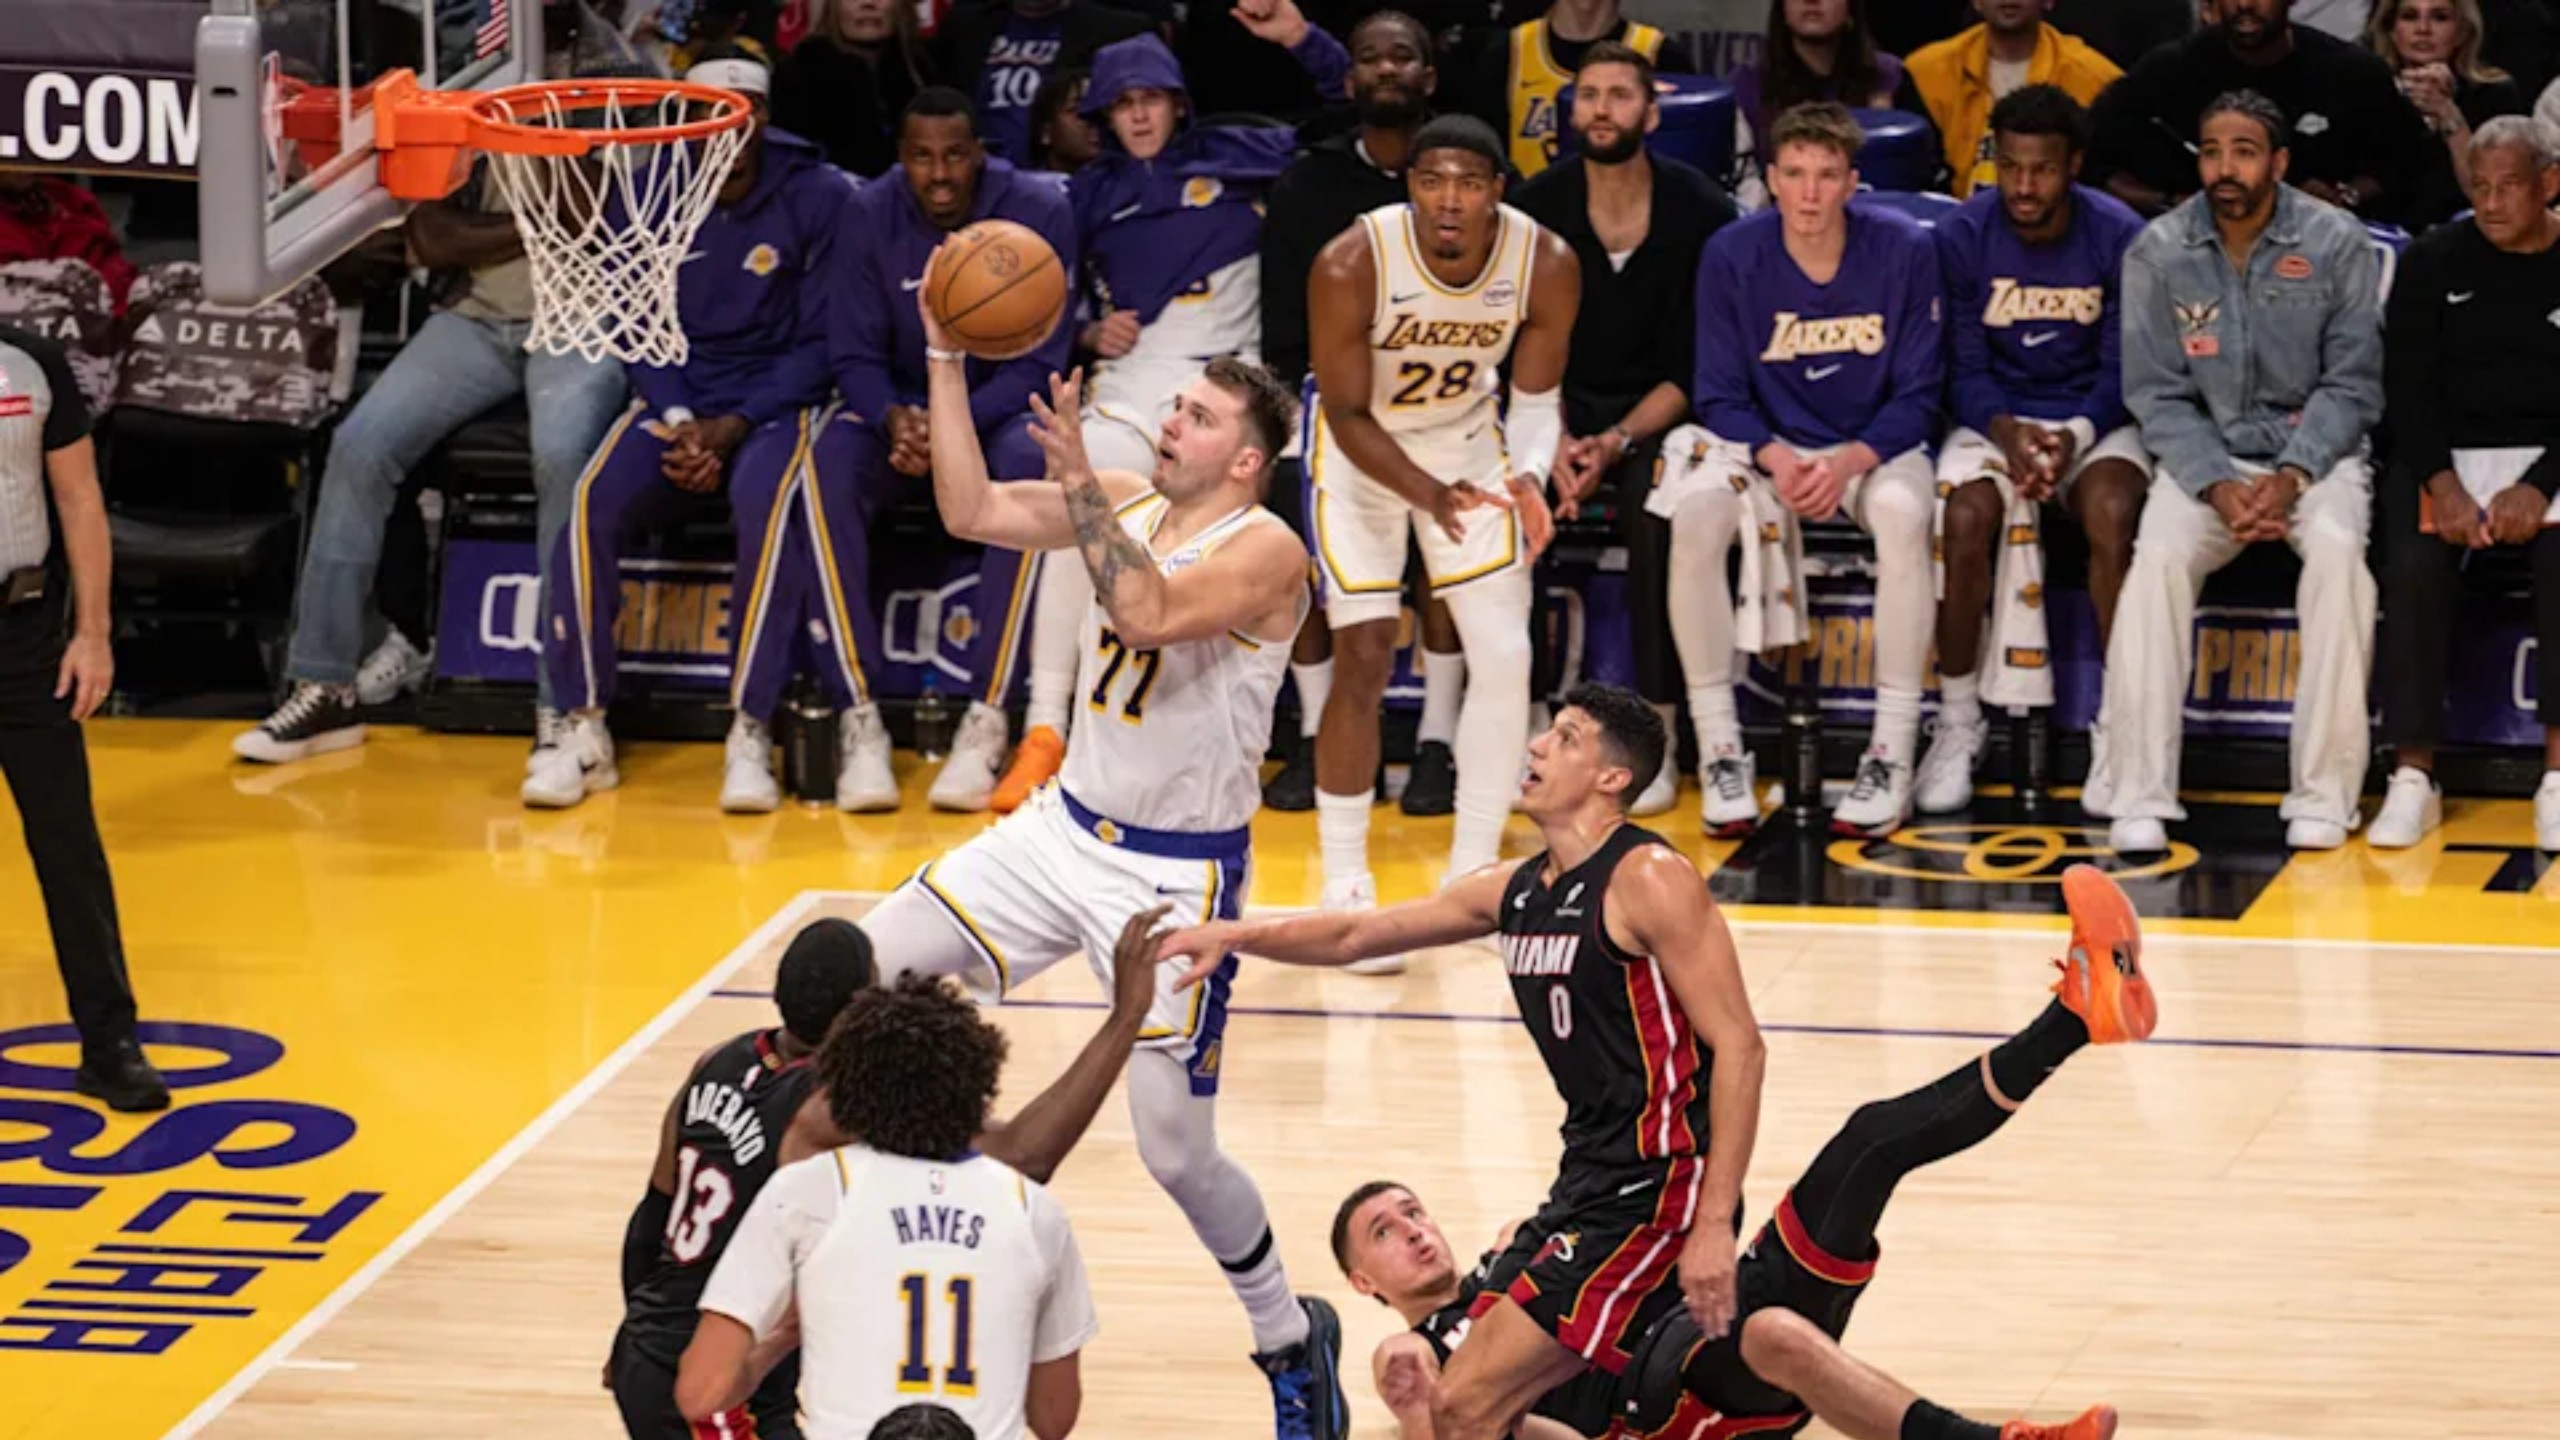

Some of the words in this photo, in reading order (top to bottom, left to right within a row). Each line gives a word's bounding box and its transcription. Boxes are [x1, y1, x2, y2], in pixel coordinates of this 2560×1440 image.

[988, 66, 1042, 108] 10
[1982, 278, 2104, 327] LAKERS
[177, 318, 303, 352] DELTA
[1373, 314, 1507, 350] LAKERS
[1760, 311, 1886, 362] LAKERS
[1388, 359, 1476, 411] 28
[1088, 623, 1162, 728] 77
[1549, 982, 1574, 1042] 0
[685, 1081, 767, 1168] ADEBAYO
[665, 1144, 735, 1265] 13
[891, 1204, 986, 1250] HAYES
[896, 1269, 977, 1398] 11
